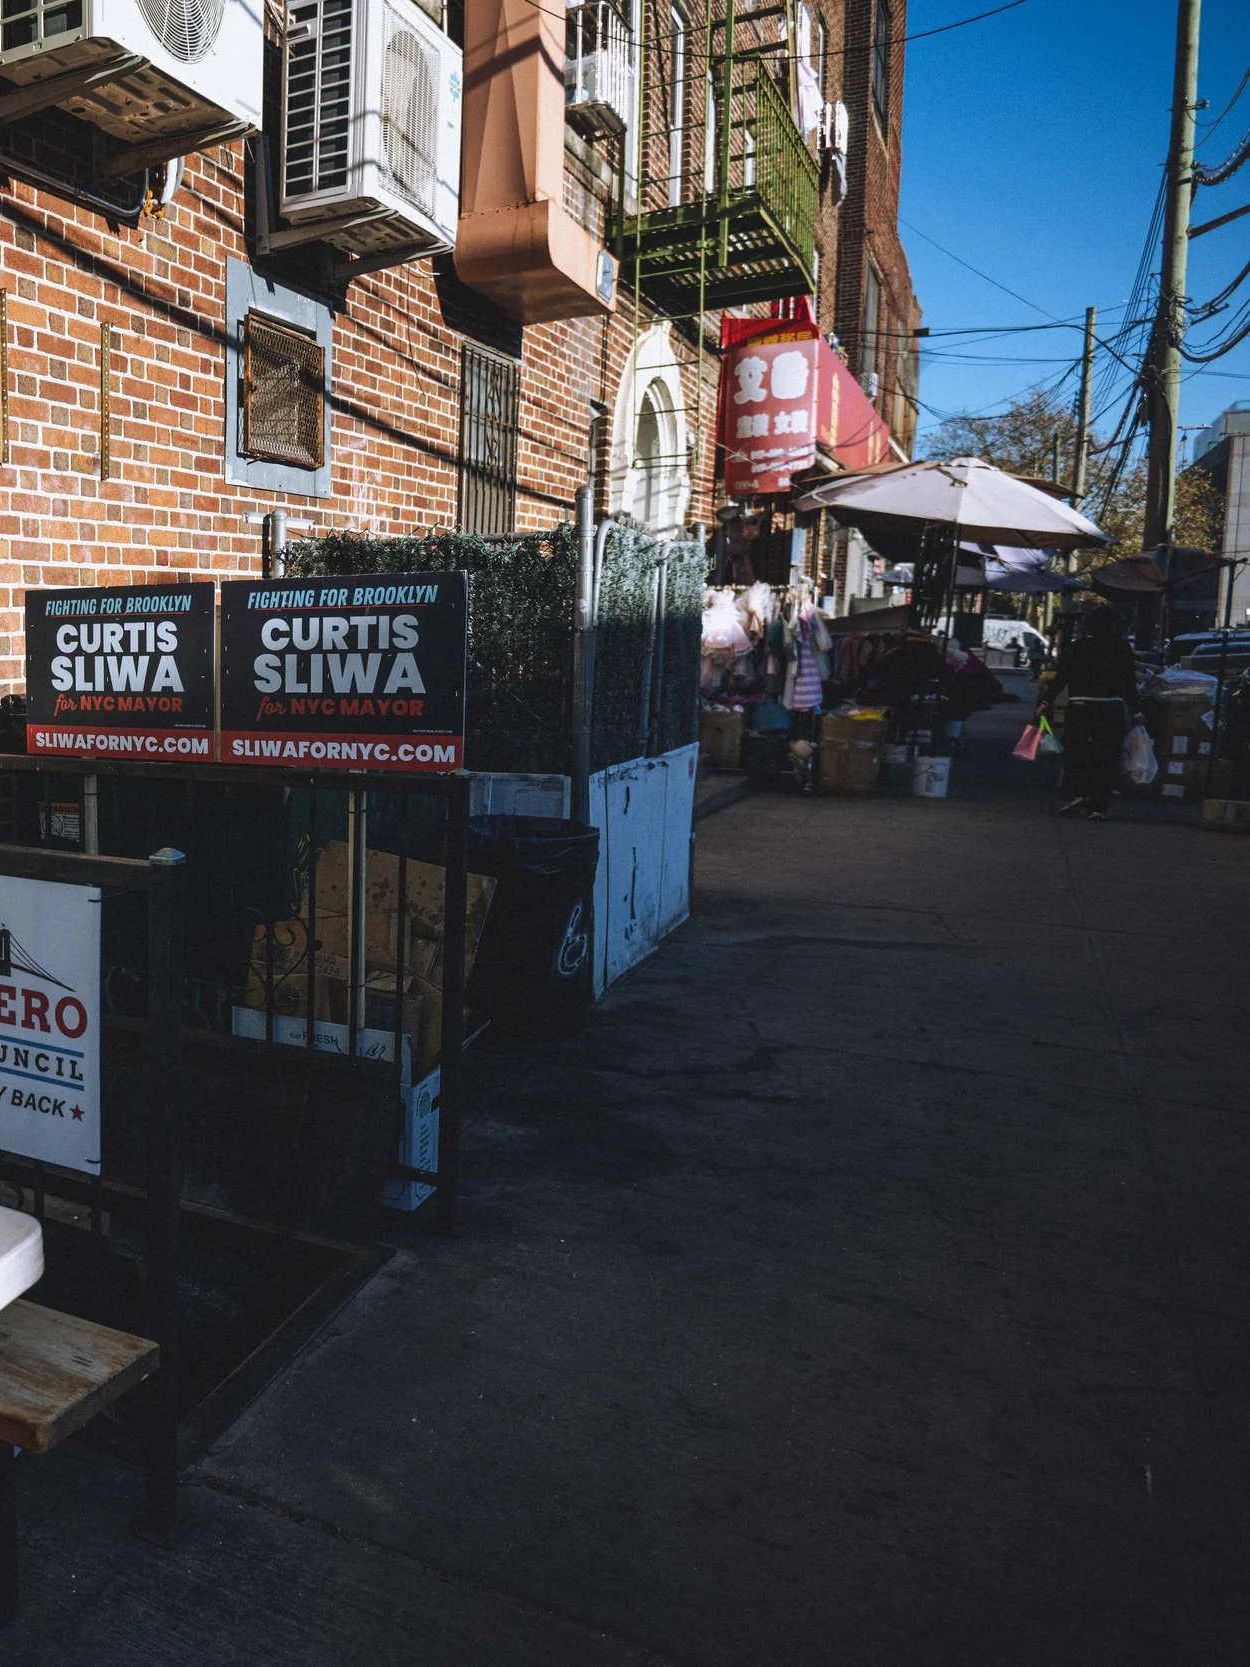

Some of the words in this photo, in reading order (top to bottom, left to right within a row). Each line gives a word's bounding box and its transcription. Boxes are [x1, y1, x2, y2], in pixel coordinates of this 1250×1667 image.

[45, 598, 97, 616] FIGHTING
[100, 597, 123, 614] FOR
[125, 595, 192, 613] BROOKLYN
[247, 589, 315, 609] FIGHTING
[320, 588, 349, 607] FOR
[352, 585, 439, 606] BROOKLYN
[56, 620, 178, 654] CURTIS
[261, 614, 419, 651] CURTIS
[51, 655, 185, 692] SLIWA
[253, 652, 427, 693] SLIWA
[53, 694, 78, 717] for
[79, 695, 115, 711] NYC
[117, 697, 183, 712] MAYOR
[256, 695, 287, 722] for
[291, 698, 336, 714] NYC
[340, 699, 425, 717] MAYOR
[35, 732, 209, 755] SLIWAFORNYC.COM
[232, 739, 456, 762] SLIWAFORNYC.COM
[303, 1032, 338, 1045] FESH
[11, 1089, 67, 1118] BACK
